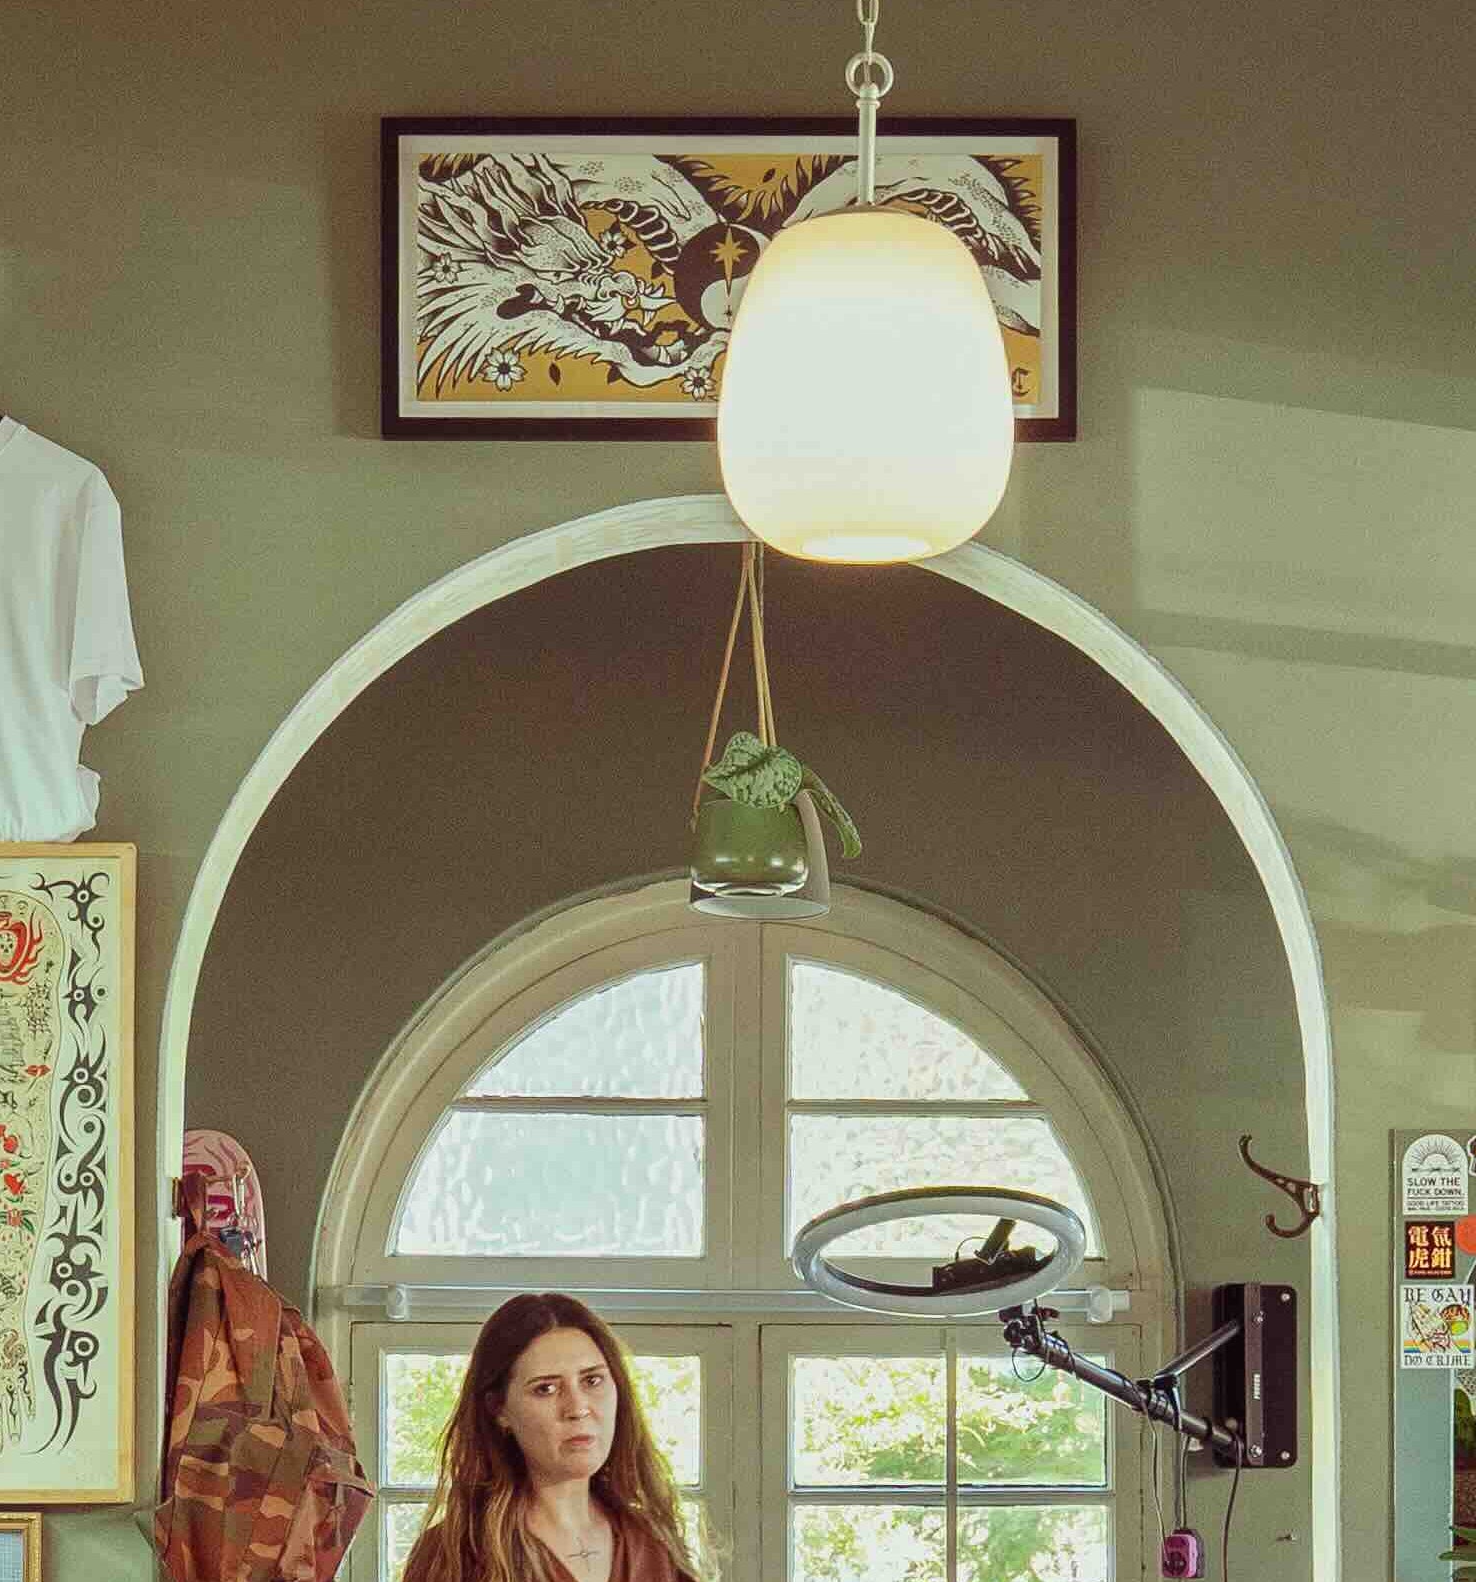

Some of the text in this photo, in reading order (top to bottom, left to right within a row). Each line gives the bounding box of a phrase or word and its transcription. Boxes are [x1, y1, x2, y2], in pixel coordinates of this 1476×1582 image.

[1407, 1177, 1461, 1186] SLOW THE
[1404, 1287, 1471, 1306] BE GAY
[1426, 1354, 1470, 1367] CRIME
